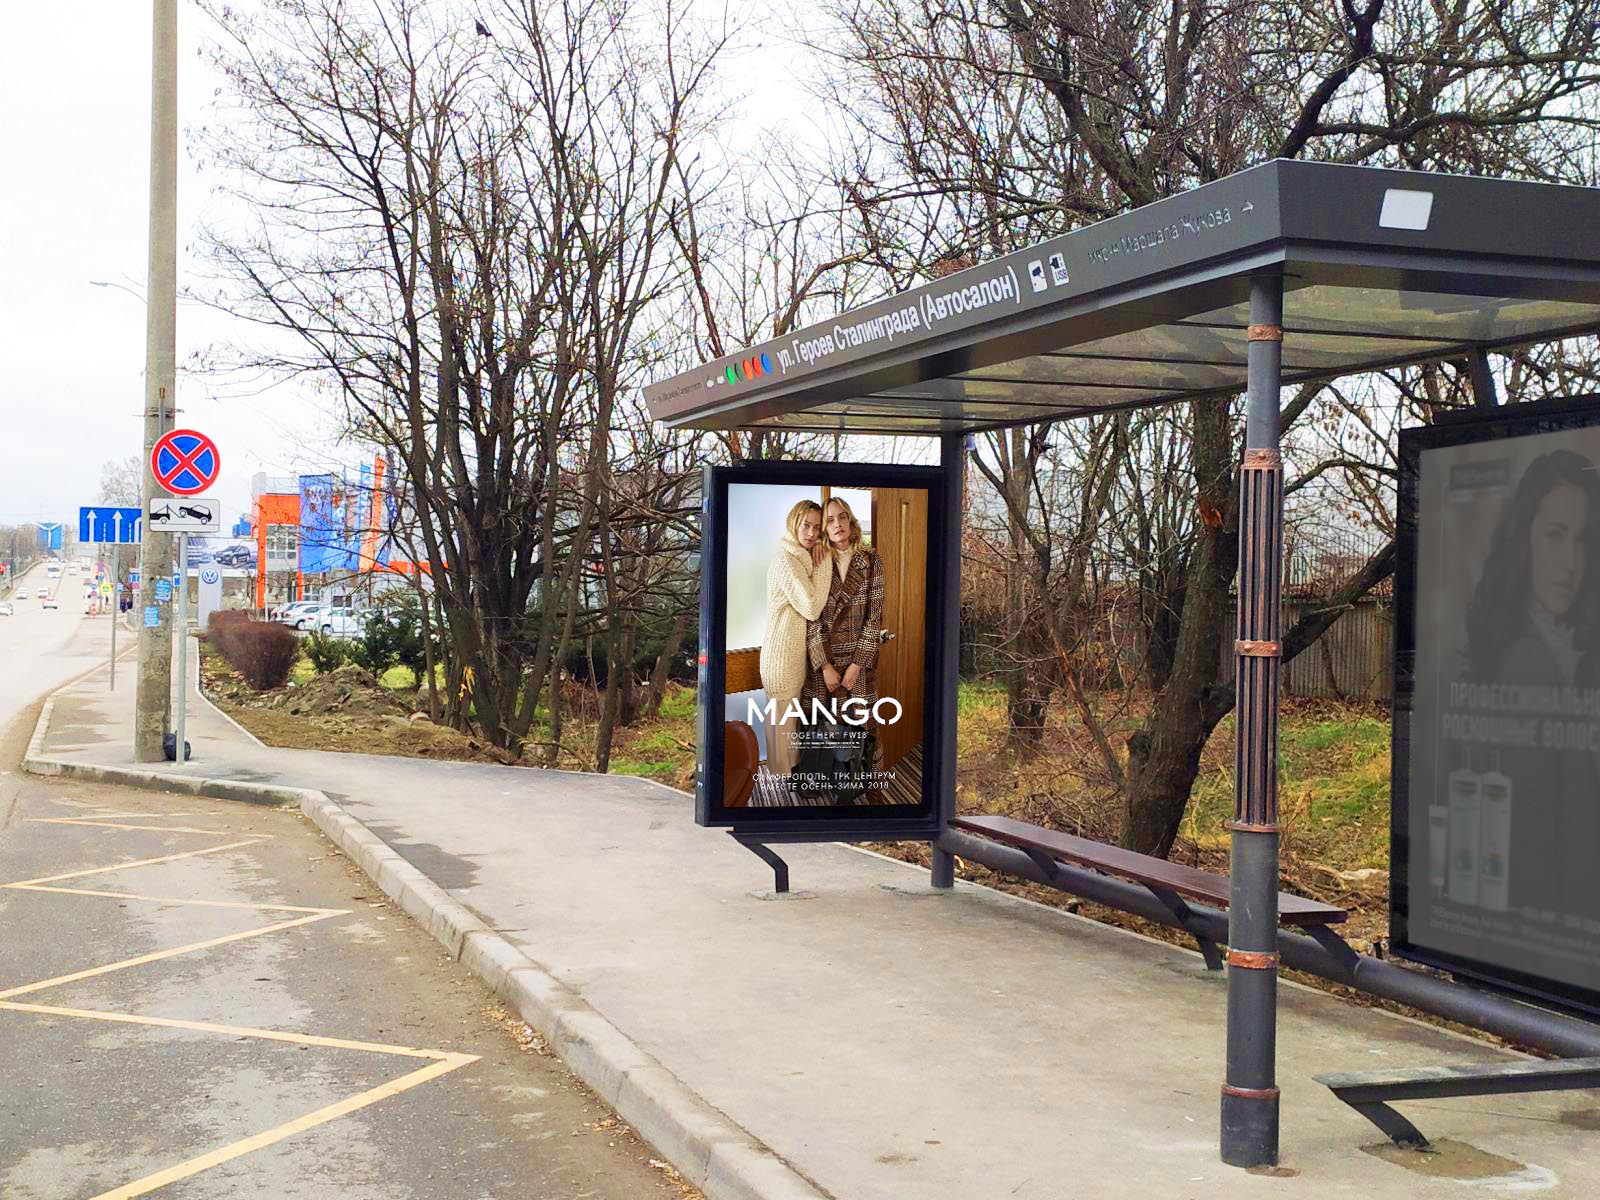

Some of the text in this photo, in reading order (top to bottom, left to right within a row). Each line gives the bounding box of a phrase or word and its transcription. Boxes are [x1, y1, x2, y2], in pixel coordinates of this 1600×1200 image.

[1054, 268, 1067, 281] USB
[776, 265, 1022, 374] ул. Героев Сталинграда (Автосалон)
[746, 696, 904, 726] MANGO
[833, 772, 850, 781] ТРК
[854, 772, 896, 781] ЦЕНТРУМ
[867, 780, 889, 790] 2018
